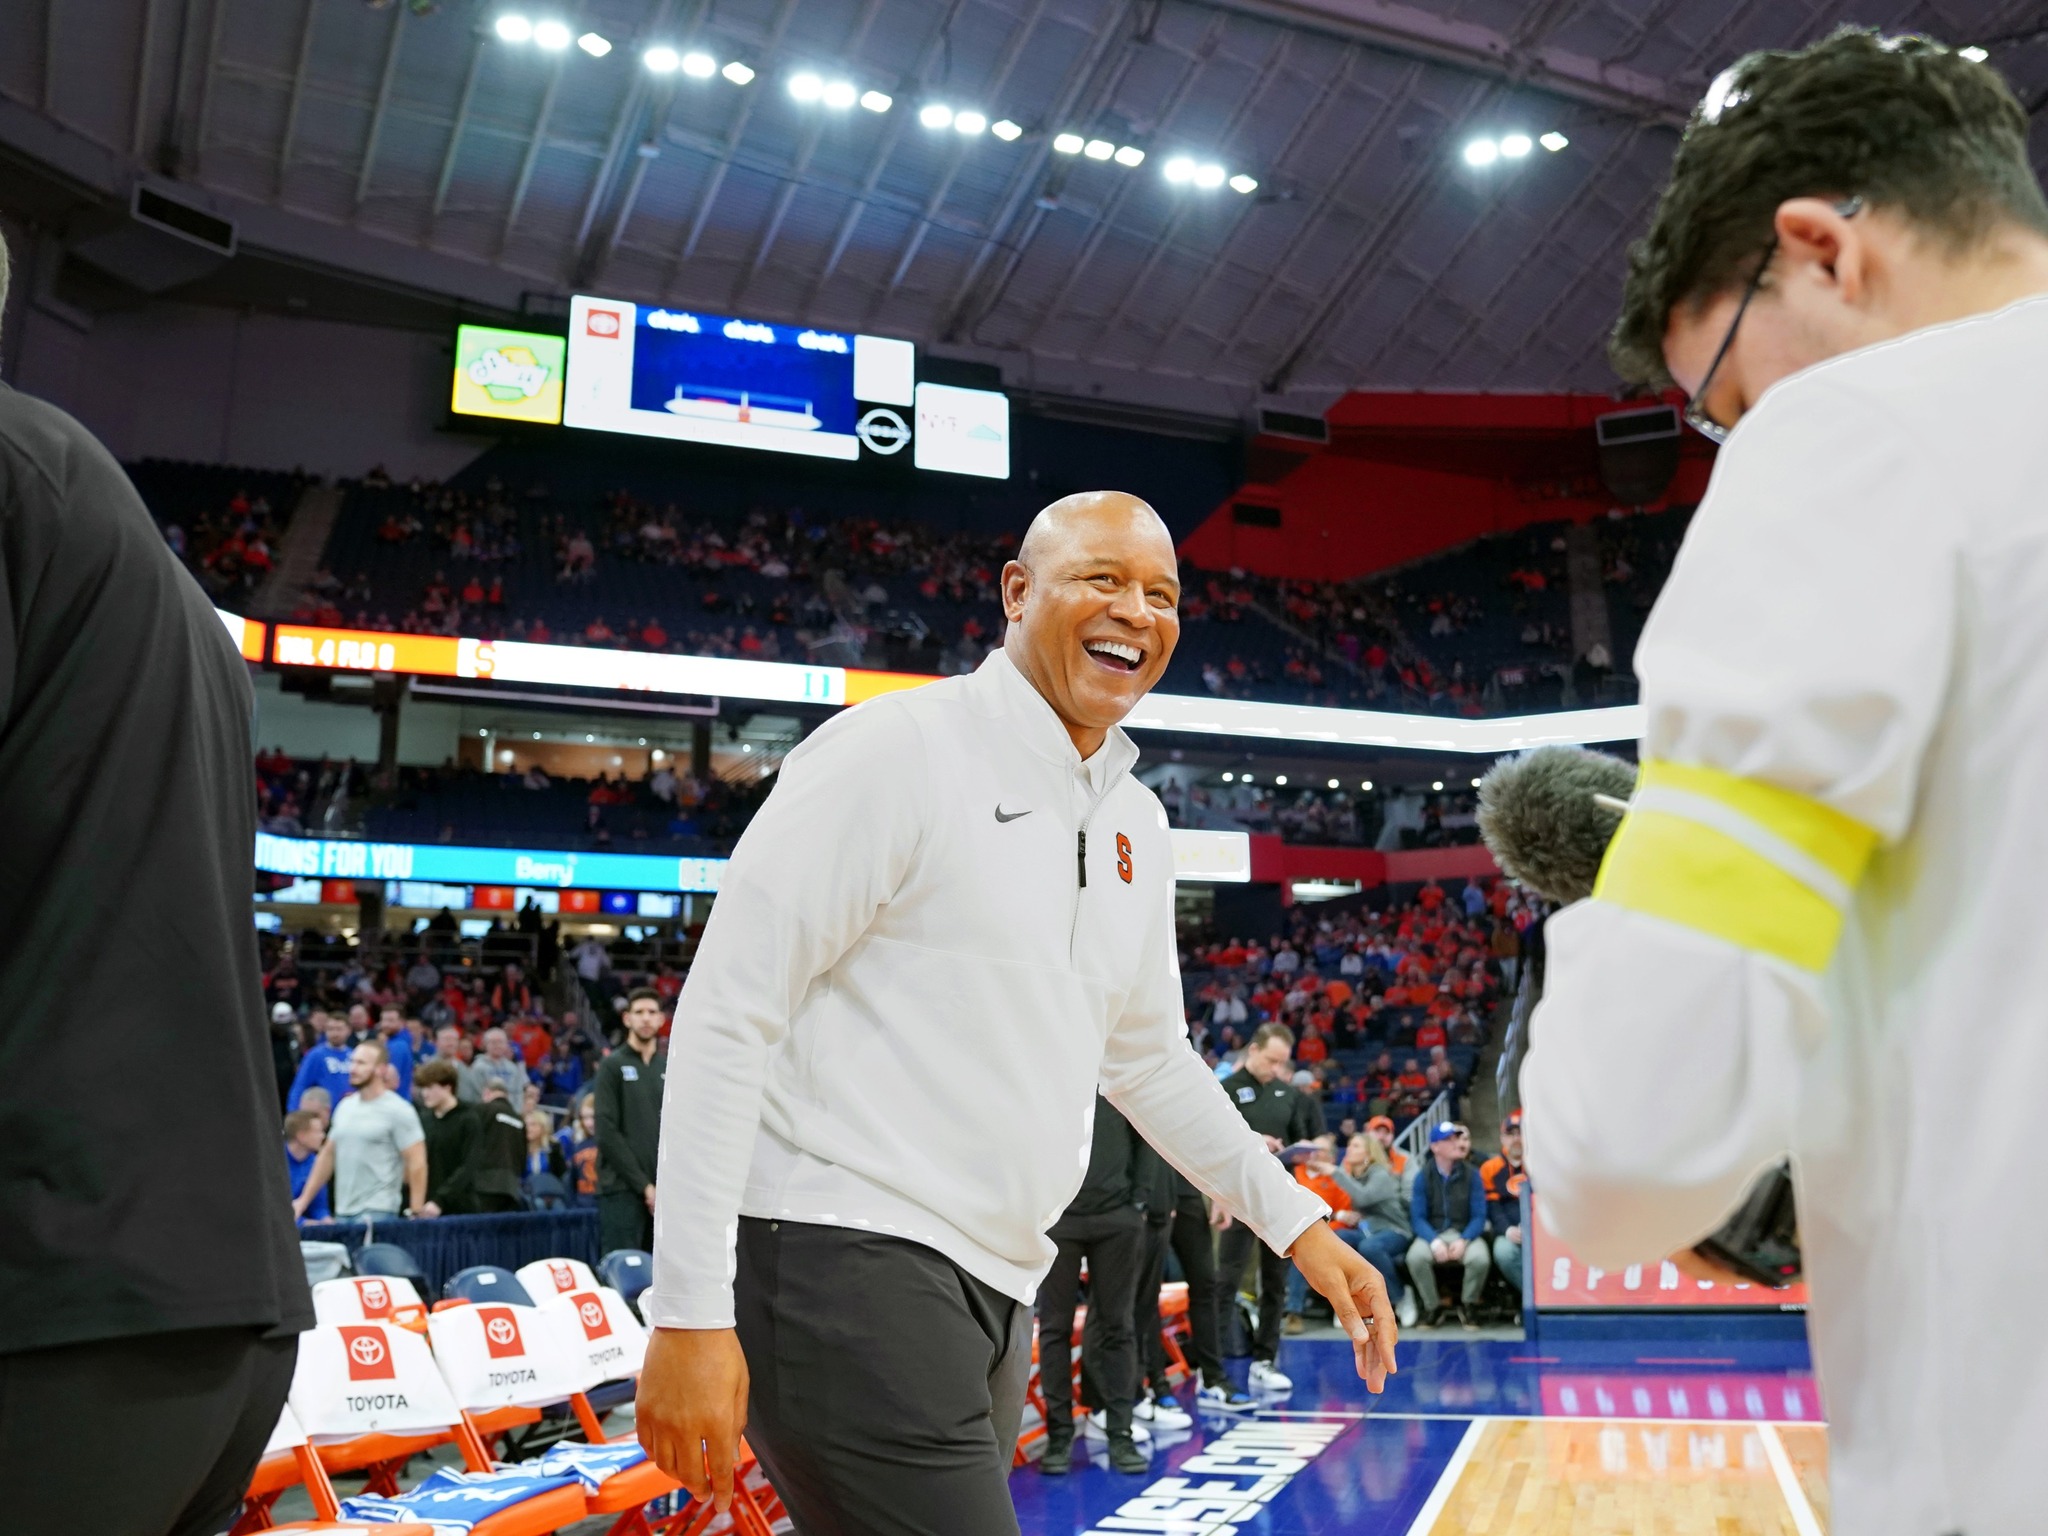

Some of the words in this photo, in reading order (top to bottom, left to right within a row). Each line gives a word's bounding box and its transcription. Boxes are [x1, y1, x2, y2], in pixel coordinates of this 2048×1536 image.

[323, 842, 367, 876] FOR
[371, 845, 413, 878] YOU
[1116, 831, 1133, 885] S
[588, 1346, 624, 1367] TOYOTA
[488, 1368, 537, 1388] TOYOTA
[346, 1393, 409, 1413] TOYOTA
